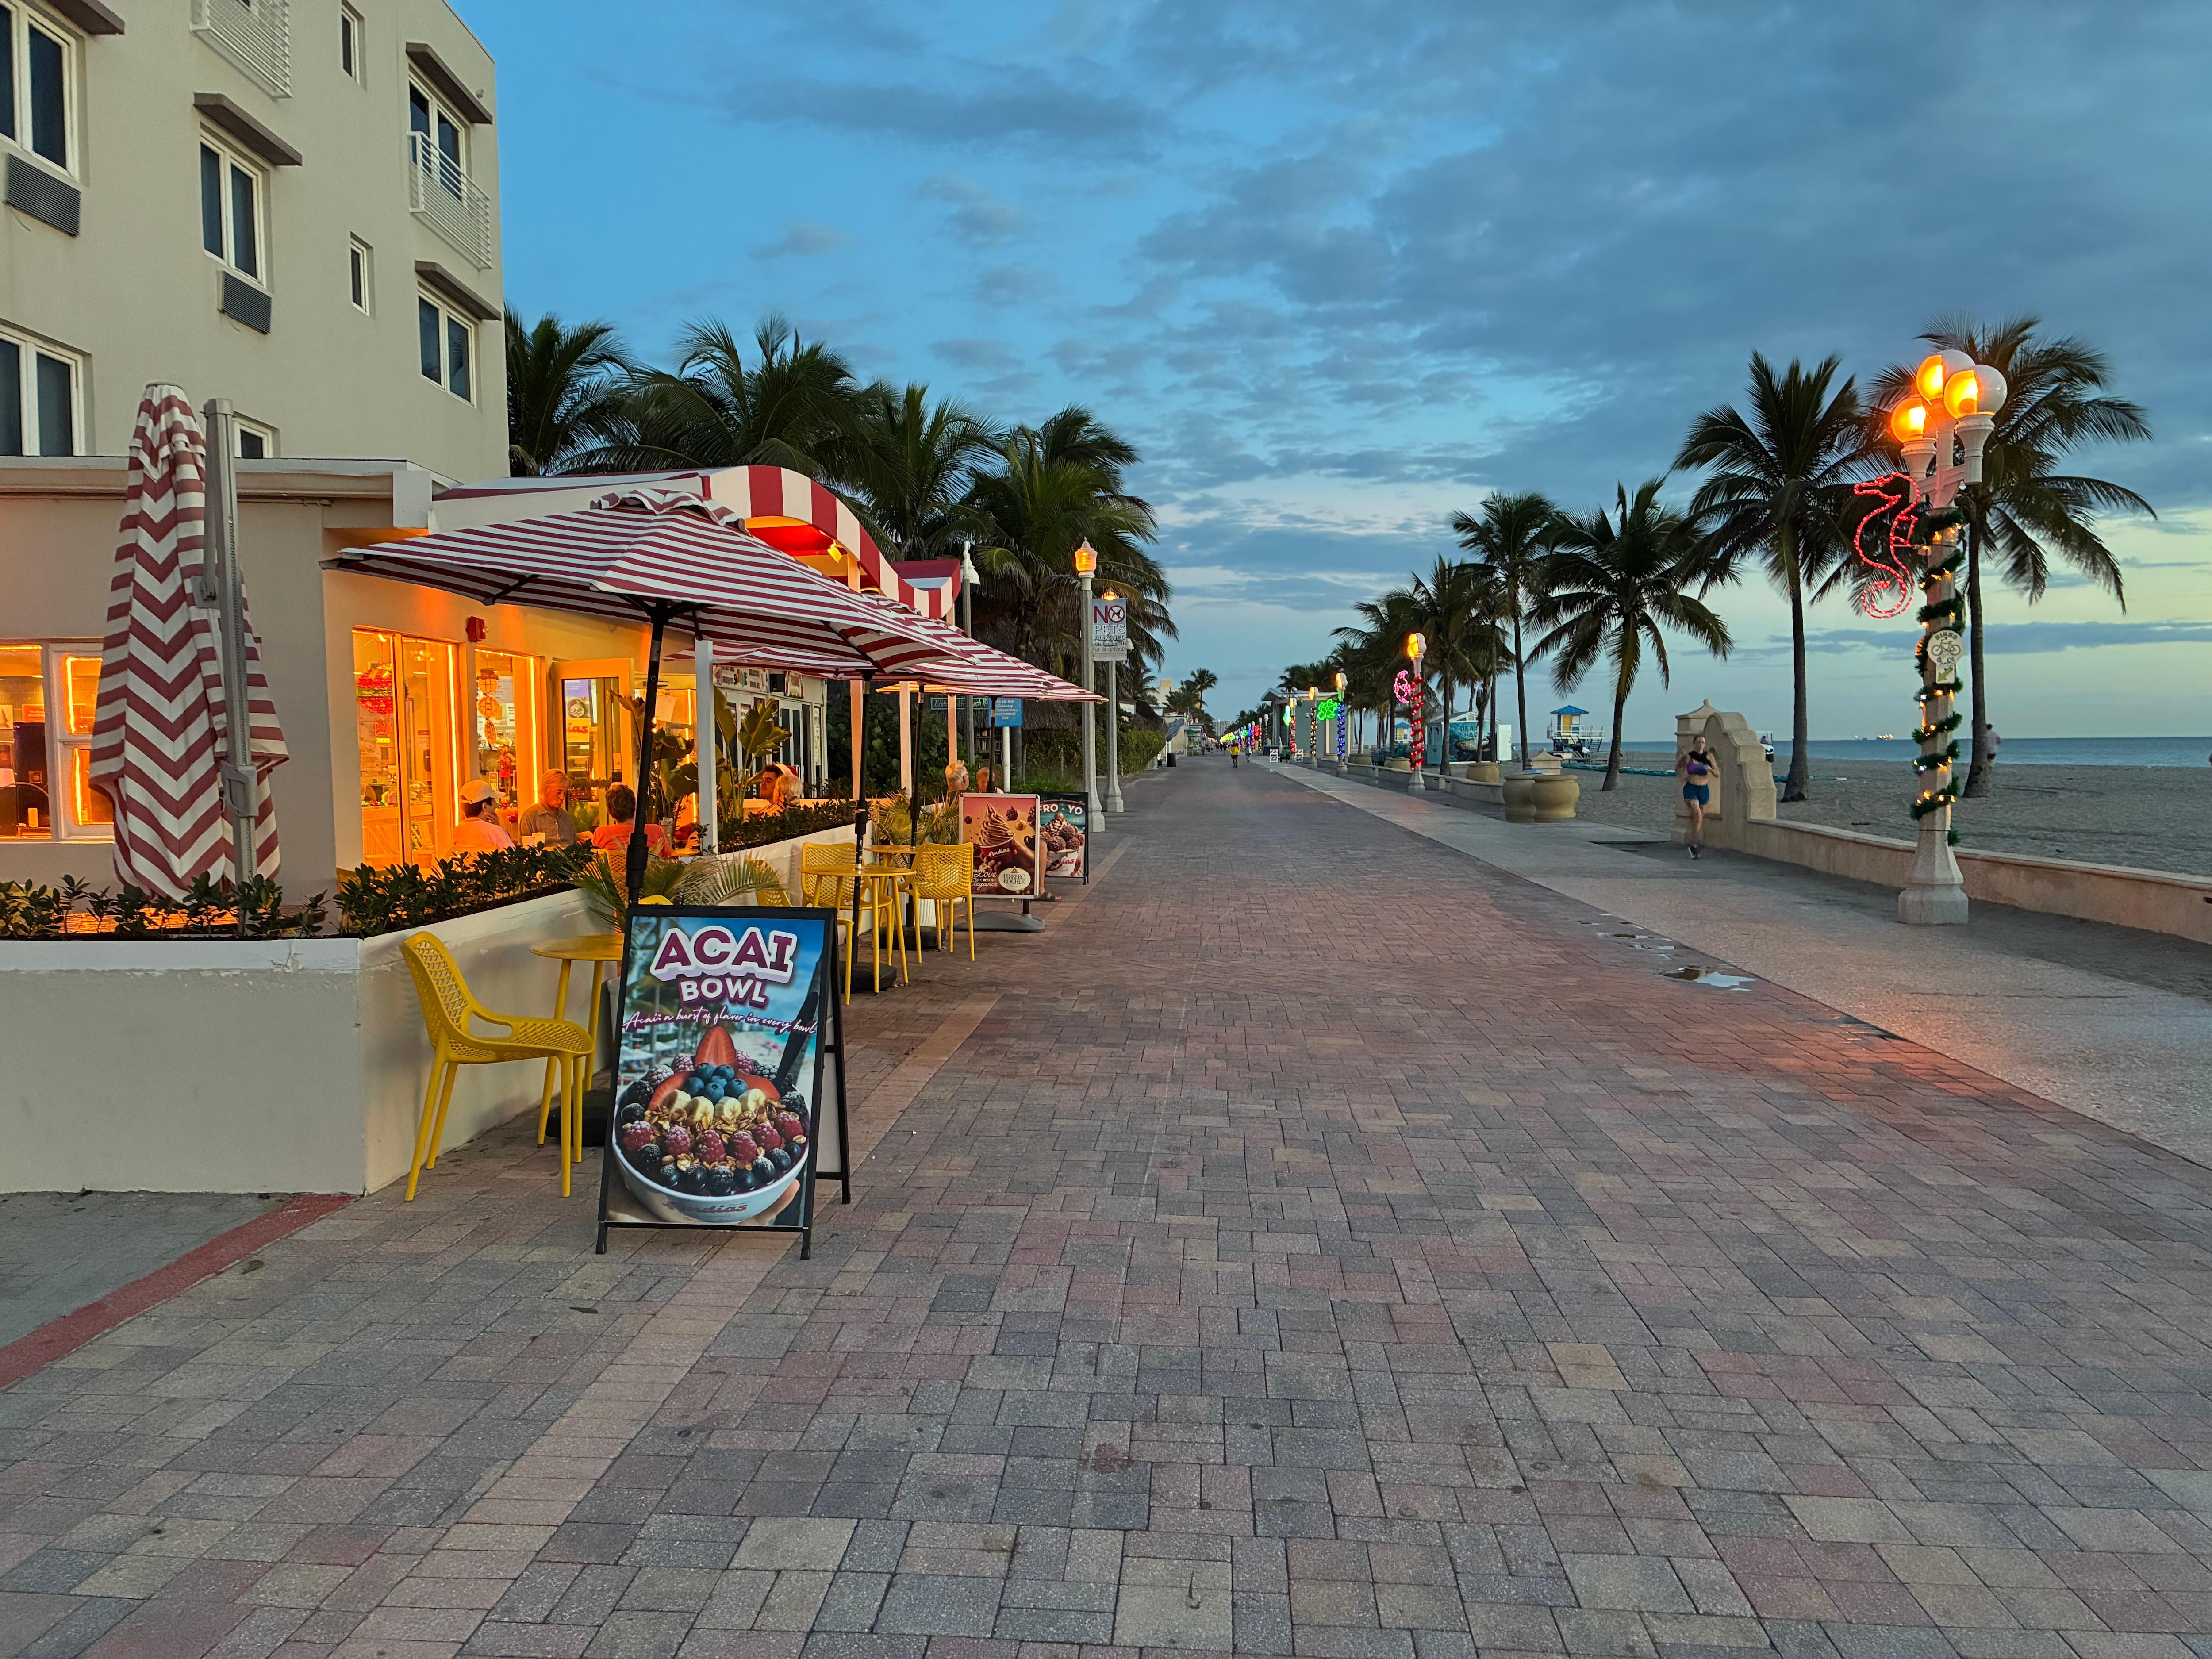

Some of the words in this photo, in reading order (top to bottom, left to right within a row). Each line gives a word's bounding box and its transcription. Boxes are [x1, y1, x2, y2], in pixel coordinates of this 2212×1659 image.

[1093, 605, 1125, 624] NO
[1094, 624, 1126, 635] PETS
[1068, 804, 1083, 815] YO
[654, 929, 793, 973] ACAI
[680, 977, 766, 1003] BOWL
[676, 1006, 709, 1022] burst
[703, 1012, 711, 1024] of
[713, 1005, 745, 1025] flavor
[747, 1013, 760, 1022] in
[762, 1018, 792, 1033] every
[793, 1019, 818, 1033] bowl
